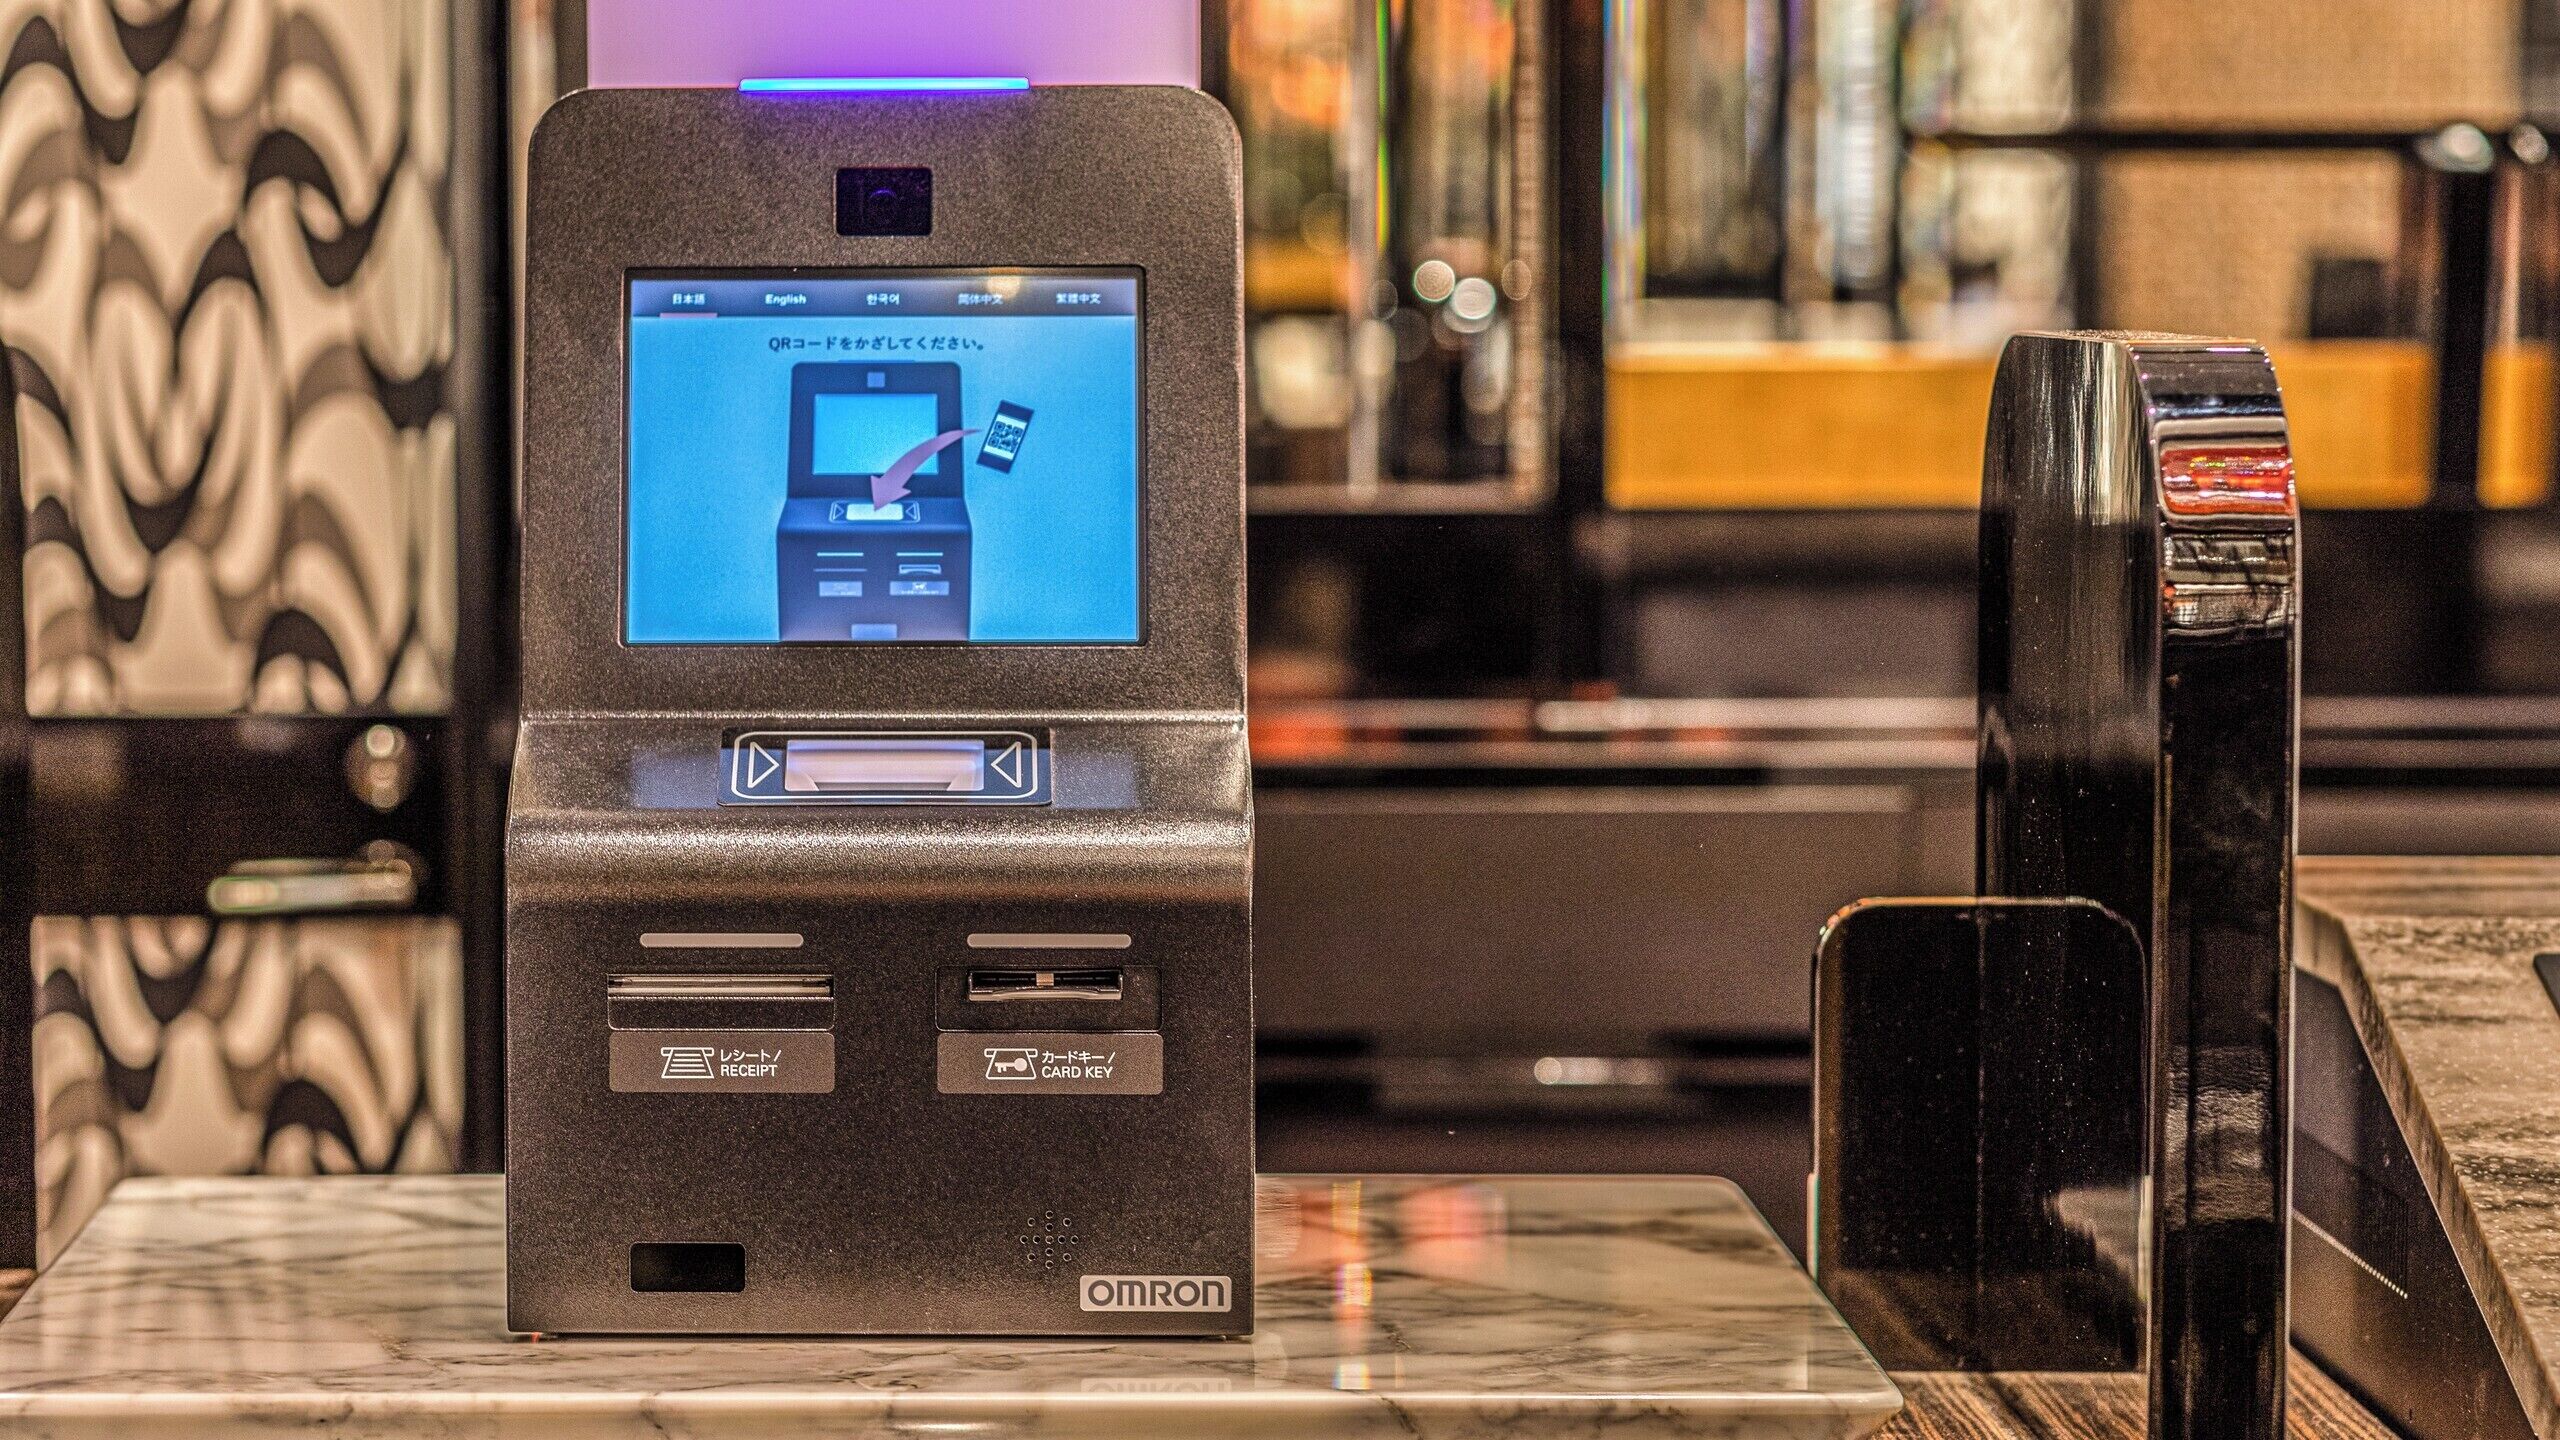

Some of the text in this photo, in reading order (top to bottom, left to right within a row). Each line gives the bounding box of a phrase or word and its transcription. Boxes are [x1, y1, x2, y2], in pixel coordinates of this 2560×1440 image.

[672, 293, 706, 305] 日本語
[765, 293, 807, 306] English
[866, 293, 900, 306] 한국어
[768, 336, 984, 352] QRコードをかざしてください。
[720, 1064, 778, 1077] RECEIPT
[1041, 1066, 1113, 1078] CARD KEY
[1087, 1279, 1225, 1307] OMRON
